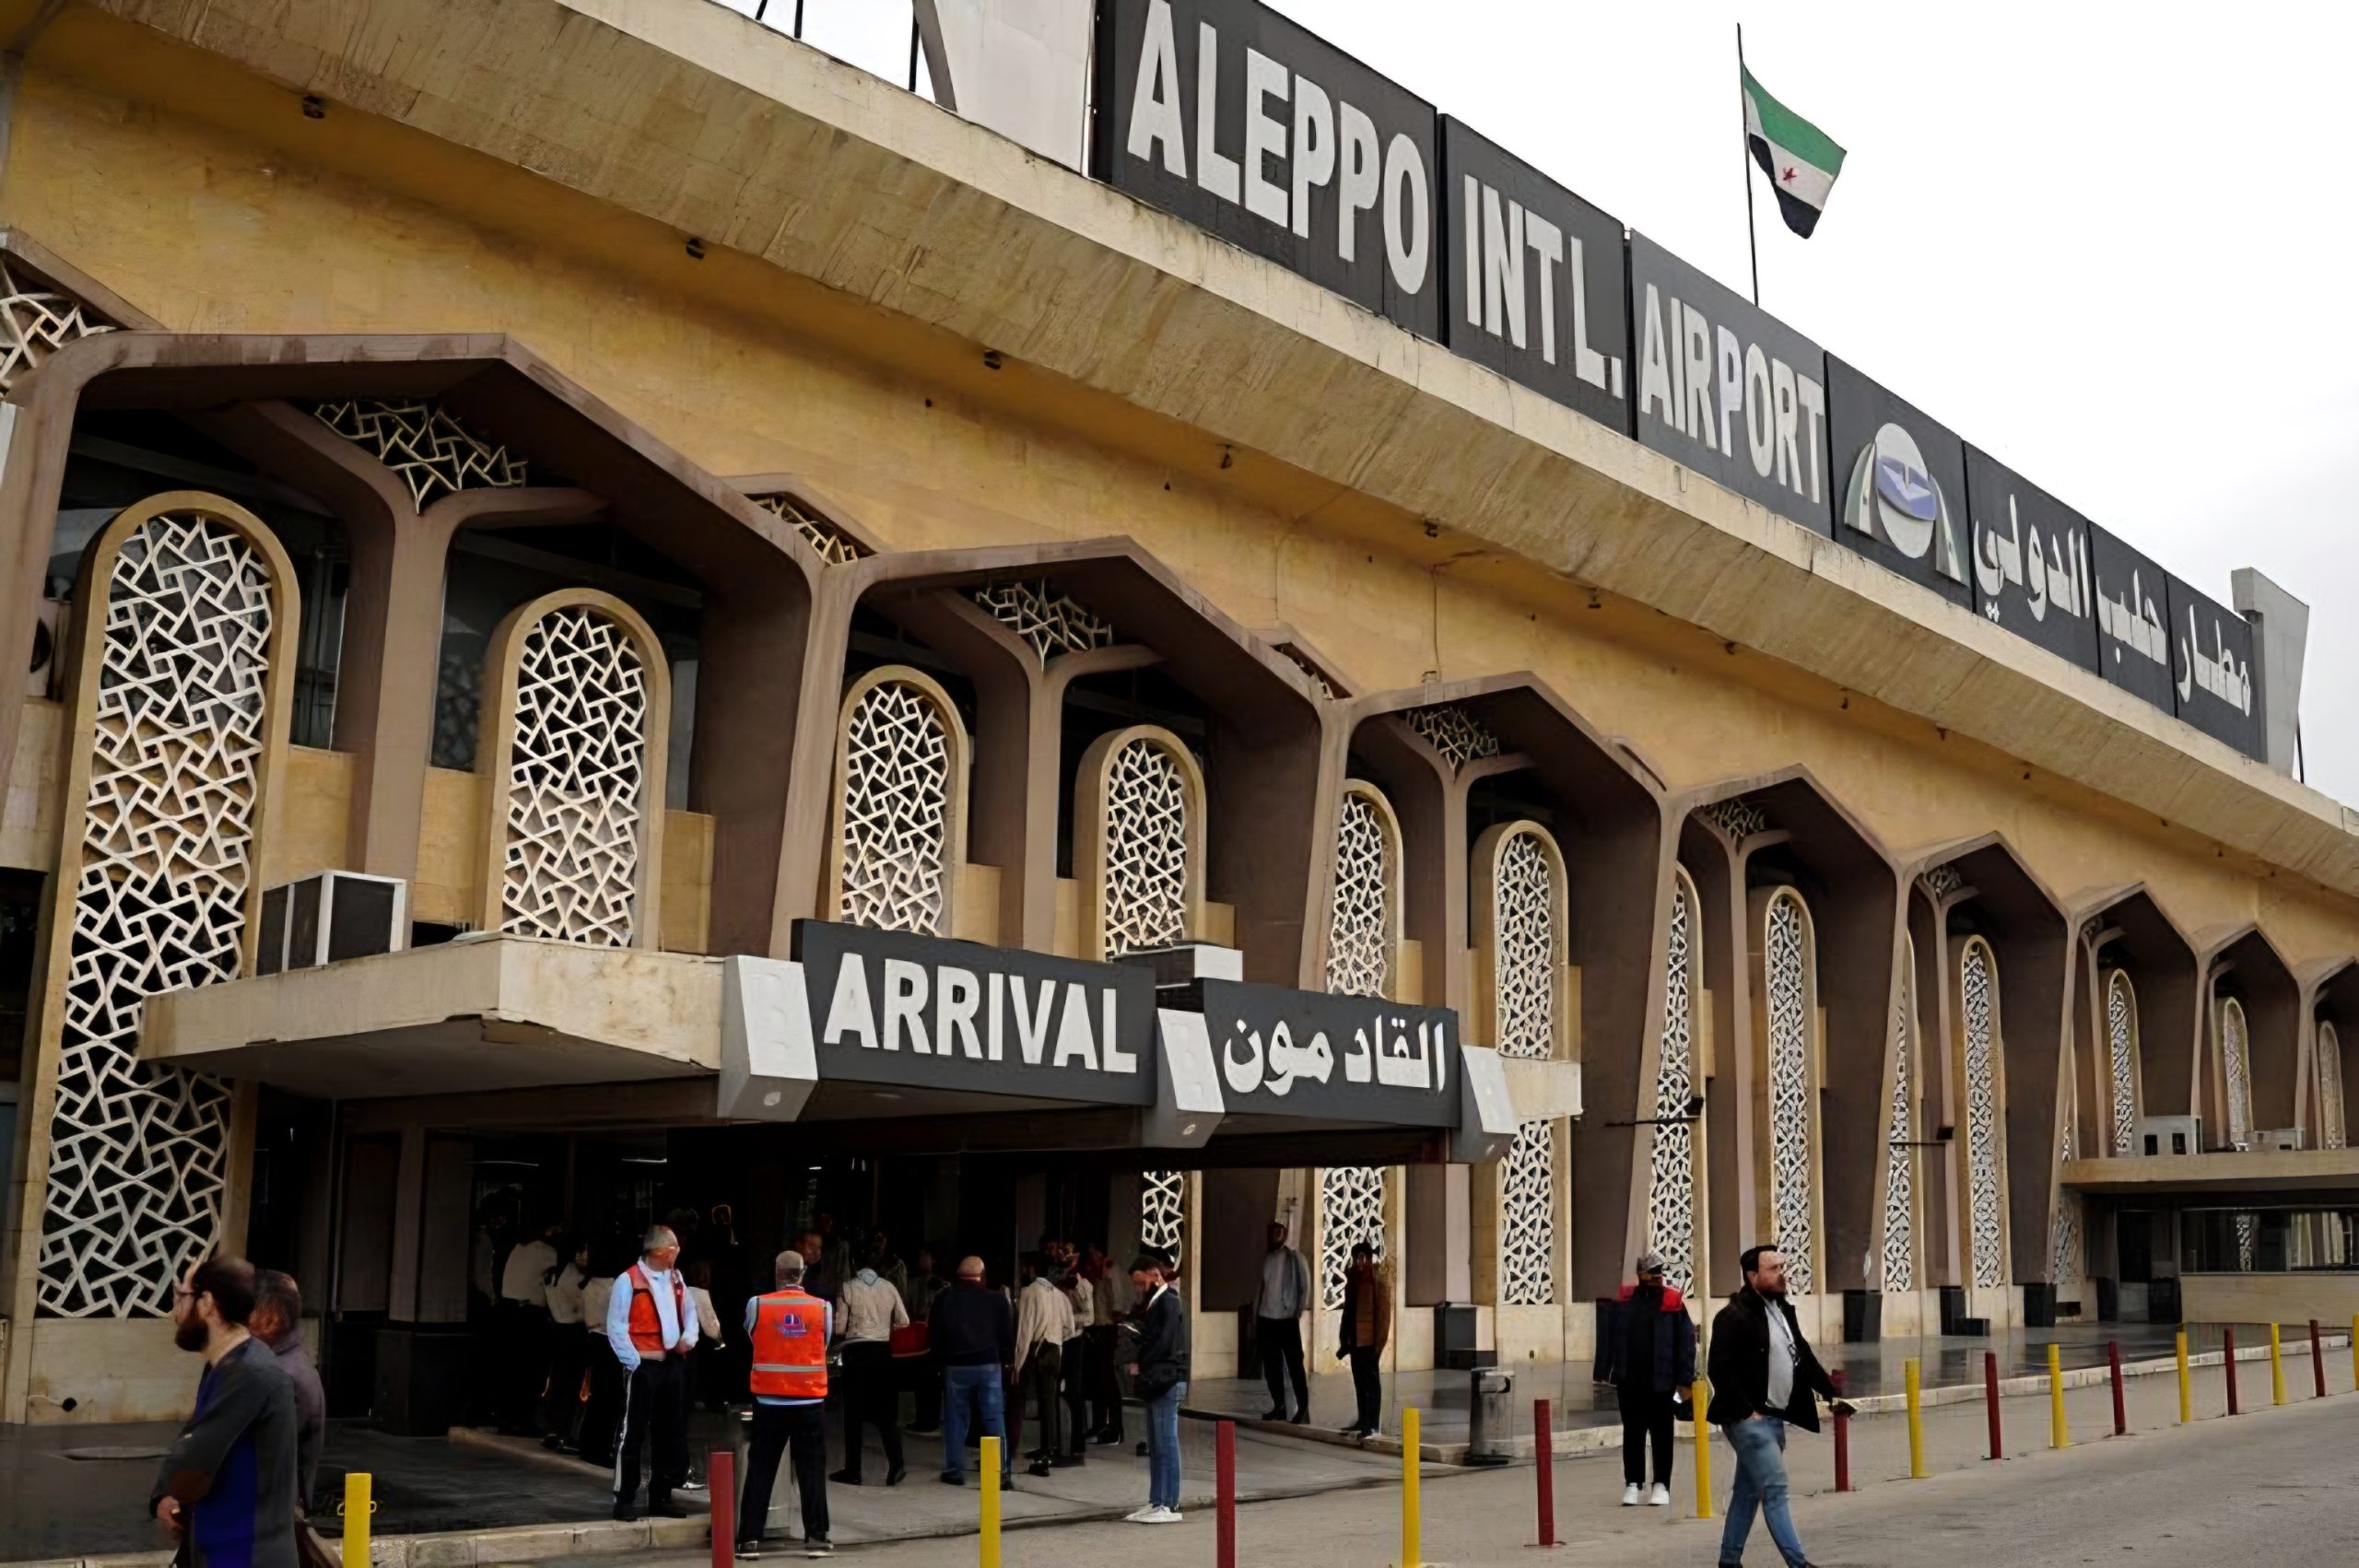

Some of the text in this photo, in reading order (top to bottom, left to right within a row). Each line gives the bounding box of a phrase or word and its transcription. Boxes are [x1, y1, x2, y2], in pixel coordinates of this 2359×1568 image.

[1127, 0, 1429, 295] ALEPPO
[1641, 283, 1825, 504] AIRPORT
[1974, 494, 2251, 717] مطار حلب الدولي
[824, 953, 1137, 1073] ARRIVAL
